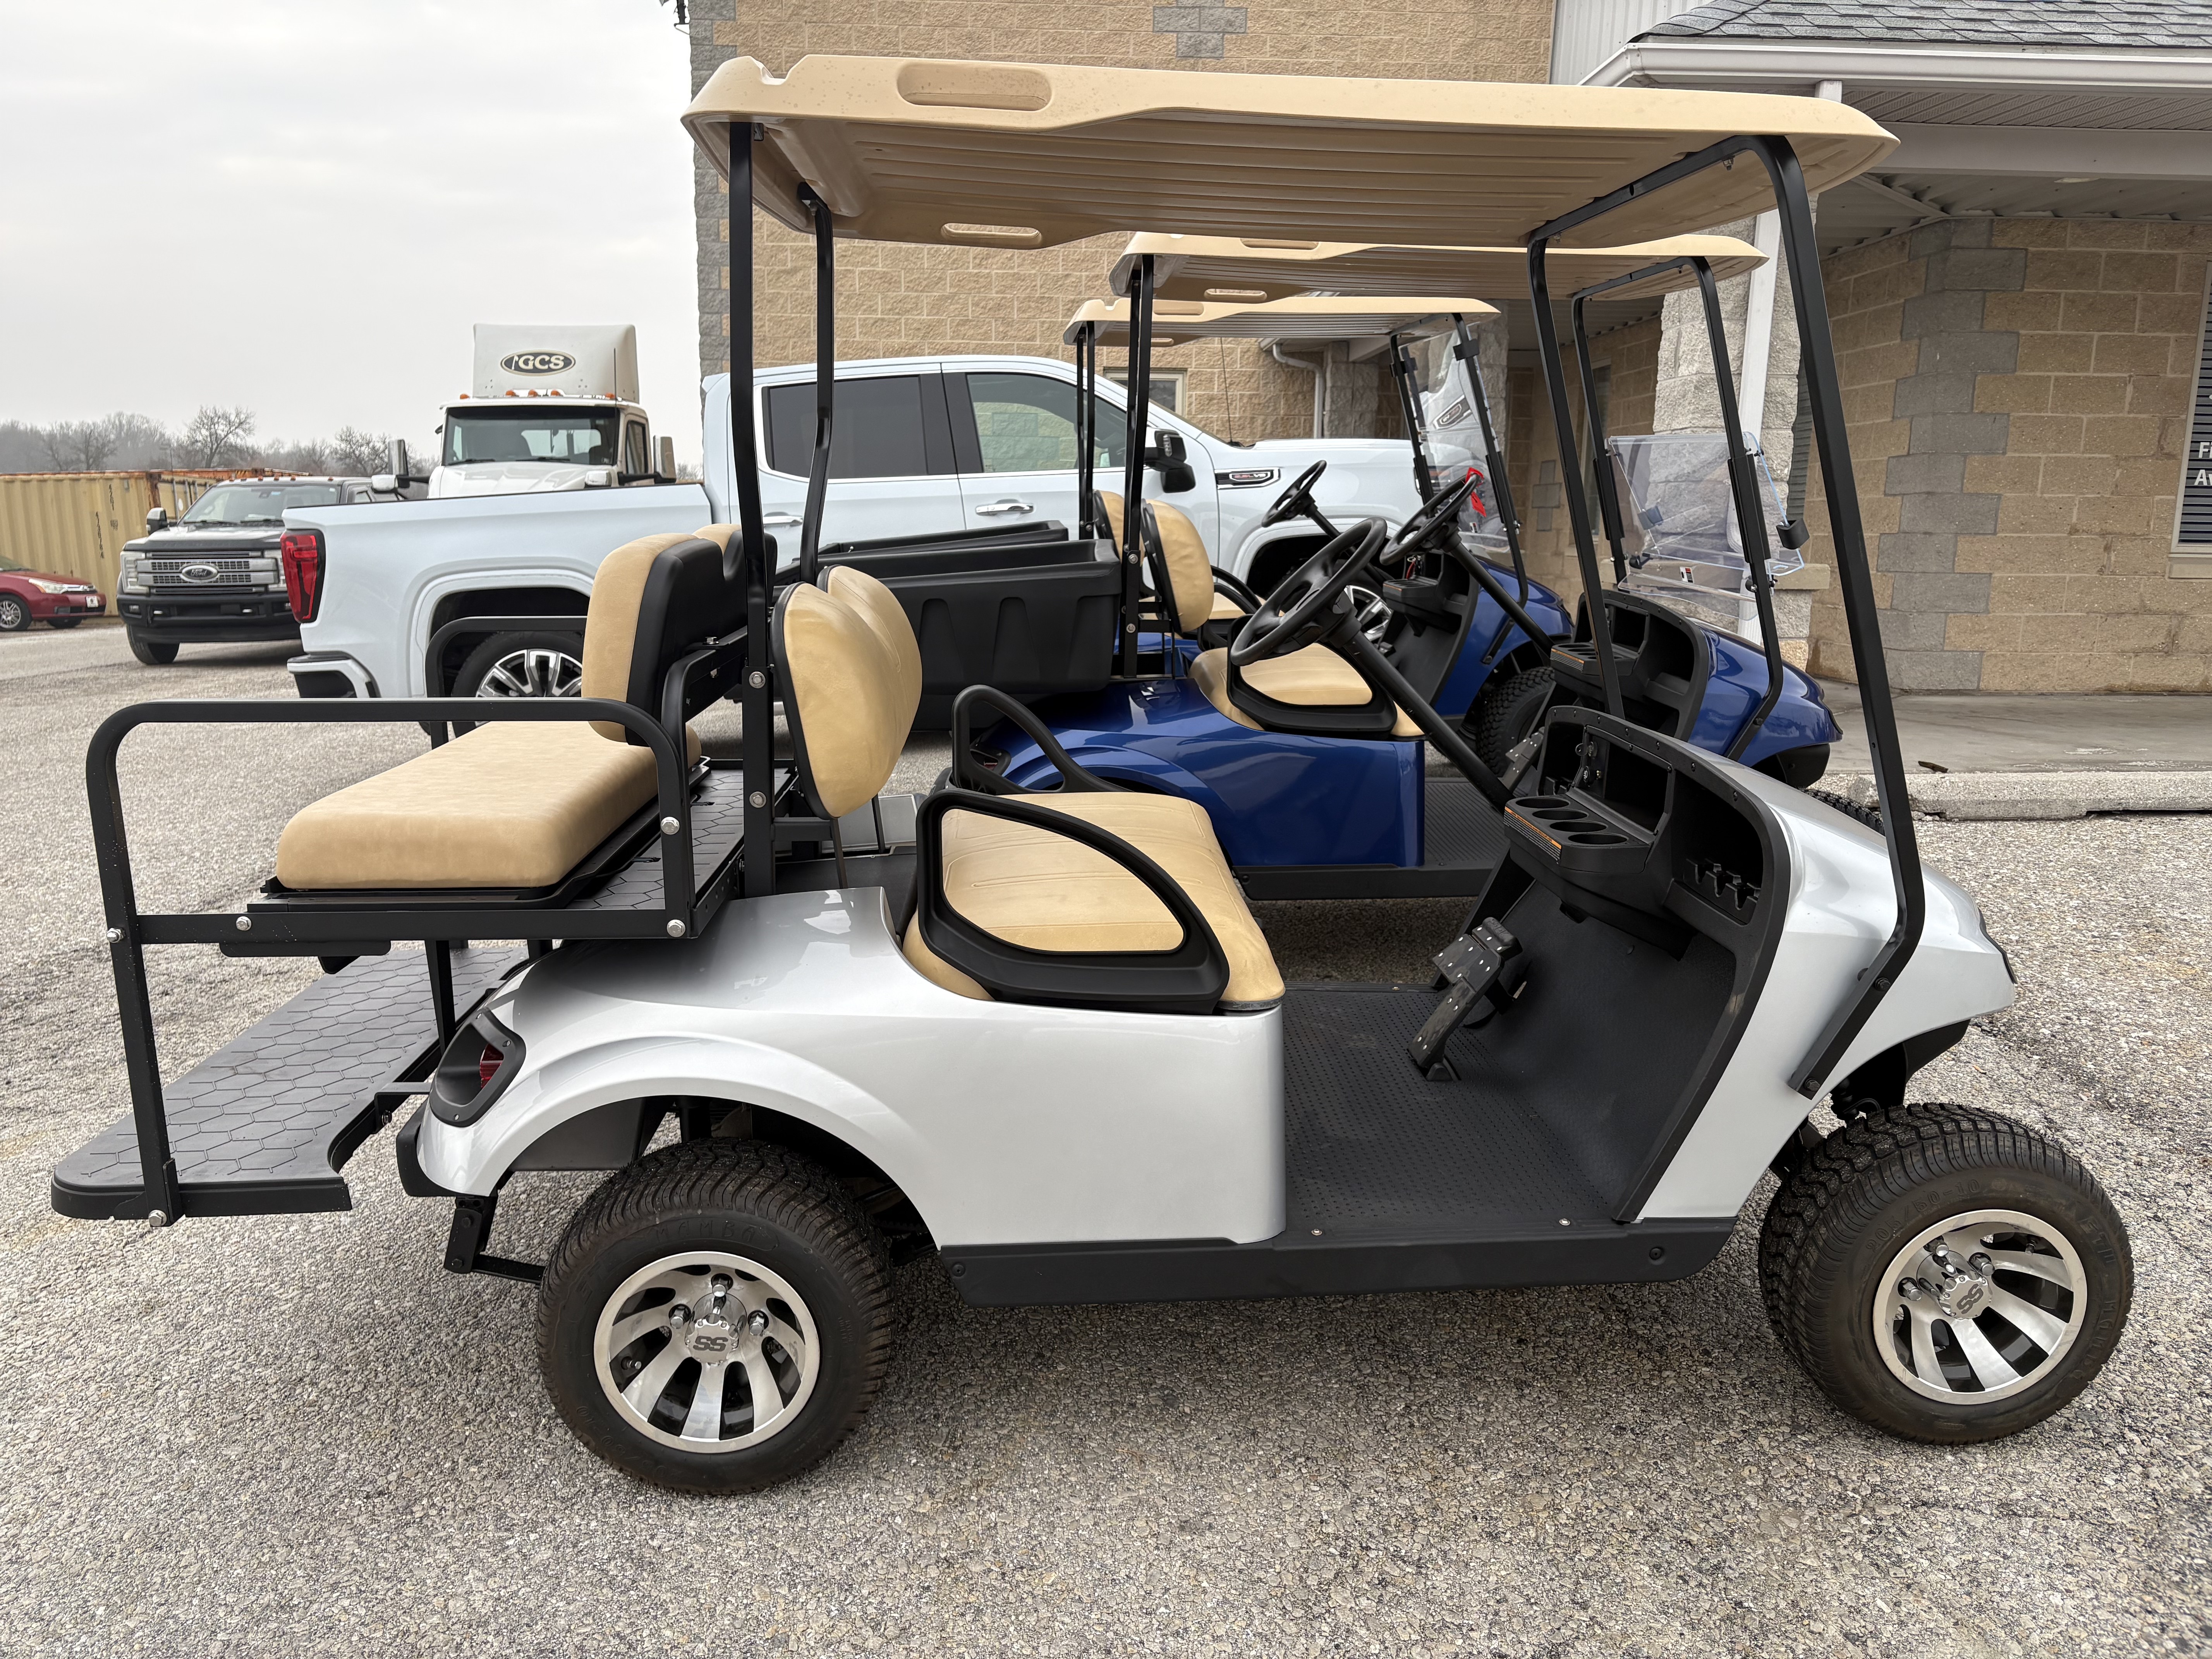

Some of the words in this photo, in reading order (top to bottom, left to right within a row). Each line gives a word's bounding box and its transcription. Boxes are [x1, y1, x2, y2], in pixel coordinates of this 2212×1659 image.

[191, 568, 207, 577] Ford
[1956, 1283, 1984, 1314] SS
[693, 1336, 729, 1352] SS
